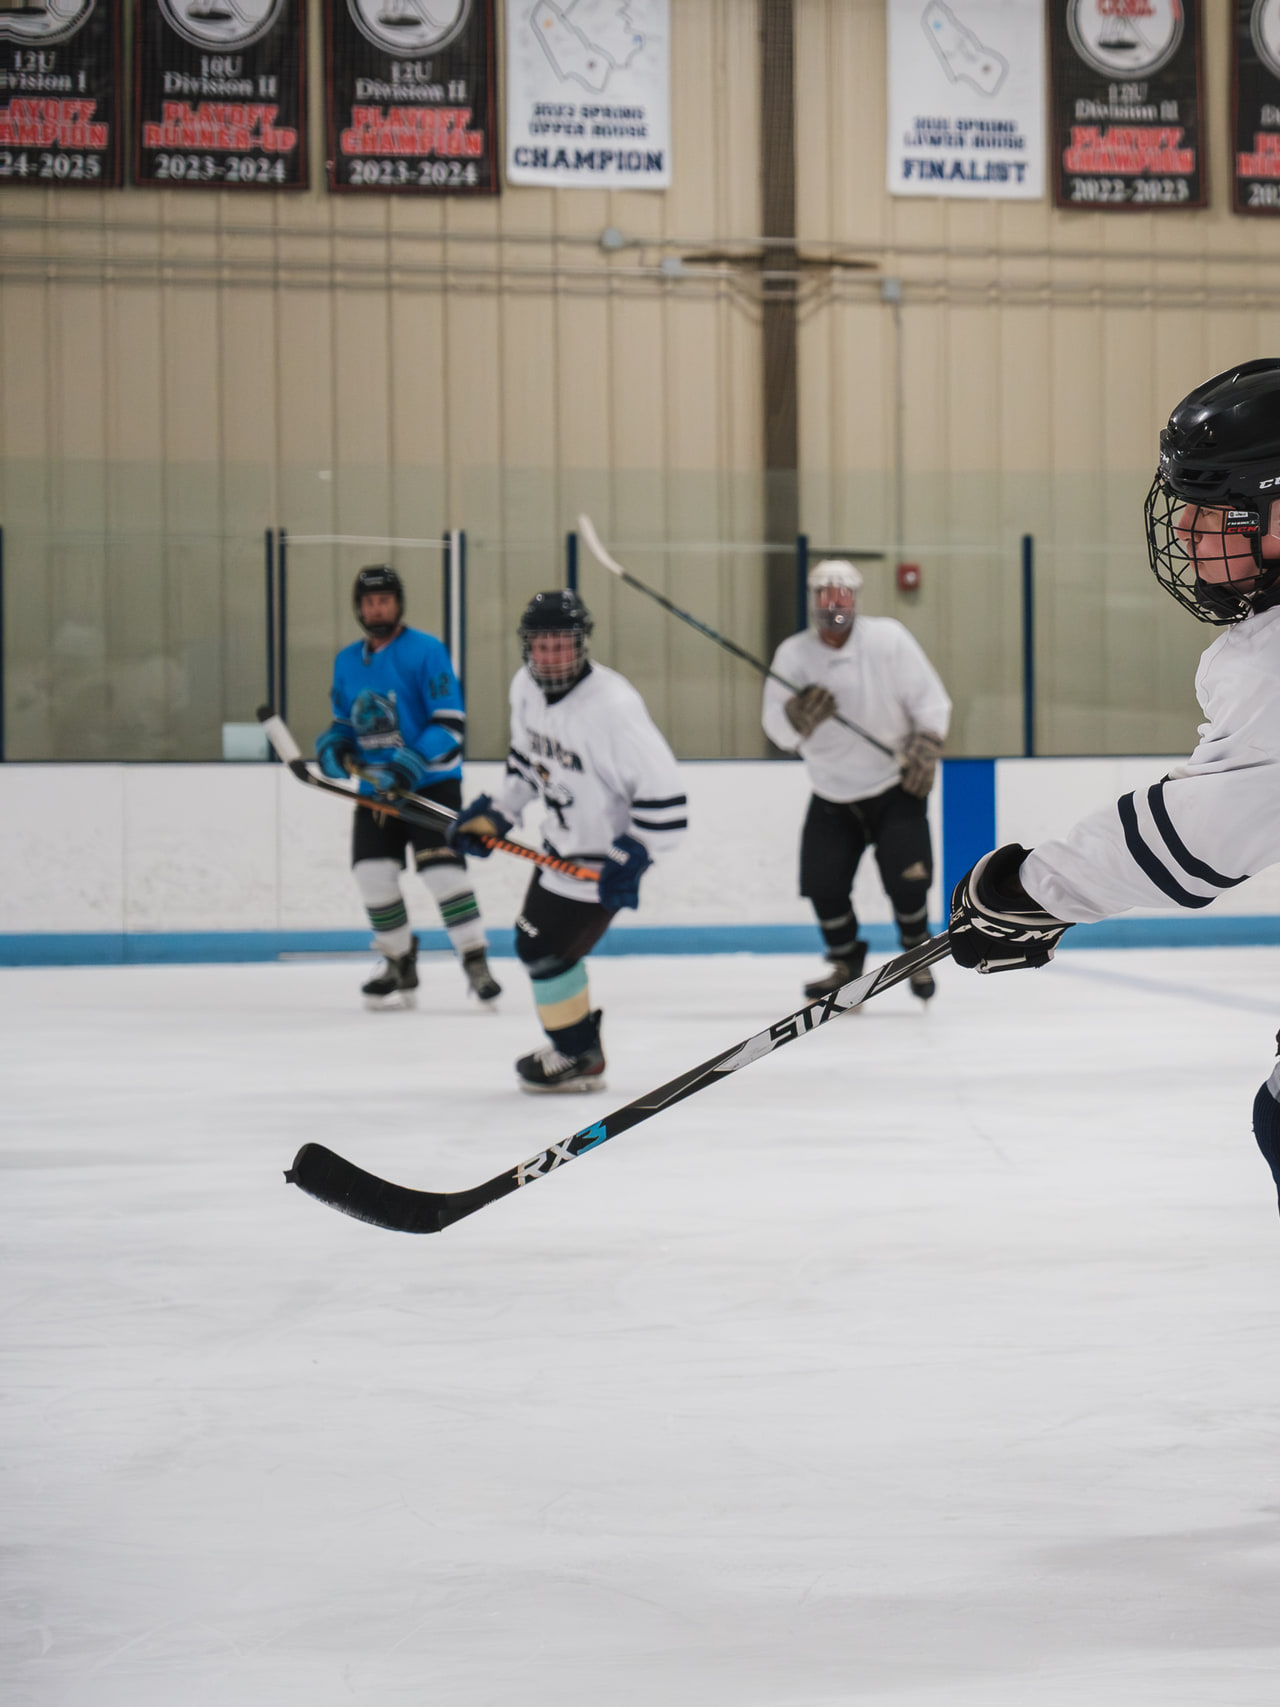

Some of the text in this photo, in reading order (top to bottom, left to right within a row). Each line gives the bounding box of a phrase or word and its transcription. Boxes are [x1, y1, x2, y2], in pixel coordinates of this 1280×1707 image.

[14, 51, 56, 72] 12U
[200, 55, 243, 77] 10U
[391, 61, 433, 82] 12U
[0, 70, 72, 91] vision
[163, 71, 277, 96] Division II
[356, 79, 466, 101] Division II
[8, 97, 97, 123] AYOFF
[161, 101, 278, 126] PLAYOFF
[352, 106, 472, 131] PLAYOFF
[1075, 99, 1157, 120] Division
[0, 121, 108, 149] AMPION
[143, 121, 297, 152] RUNNER-UP
[340, 129, 483, 157] CHAMPION
[0, 151, 101, 178] 24-2025
[155, 153, 286, 182] 2023-2024
[515, 146, 664, 172] CHAMPION
[903, 158, 1027, 183] FINALIST
[349, 160, 479, 186] 2023-2024
[769, 991, 848, 1050] STX
[513, 1119, 606, 1186] RX3
